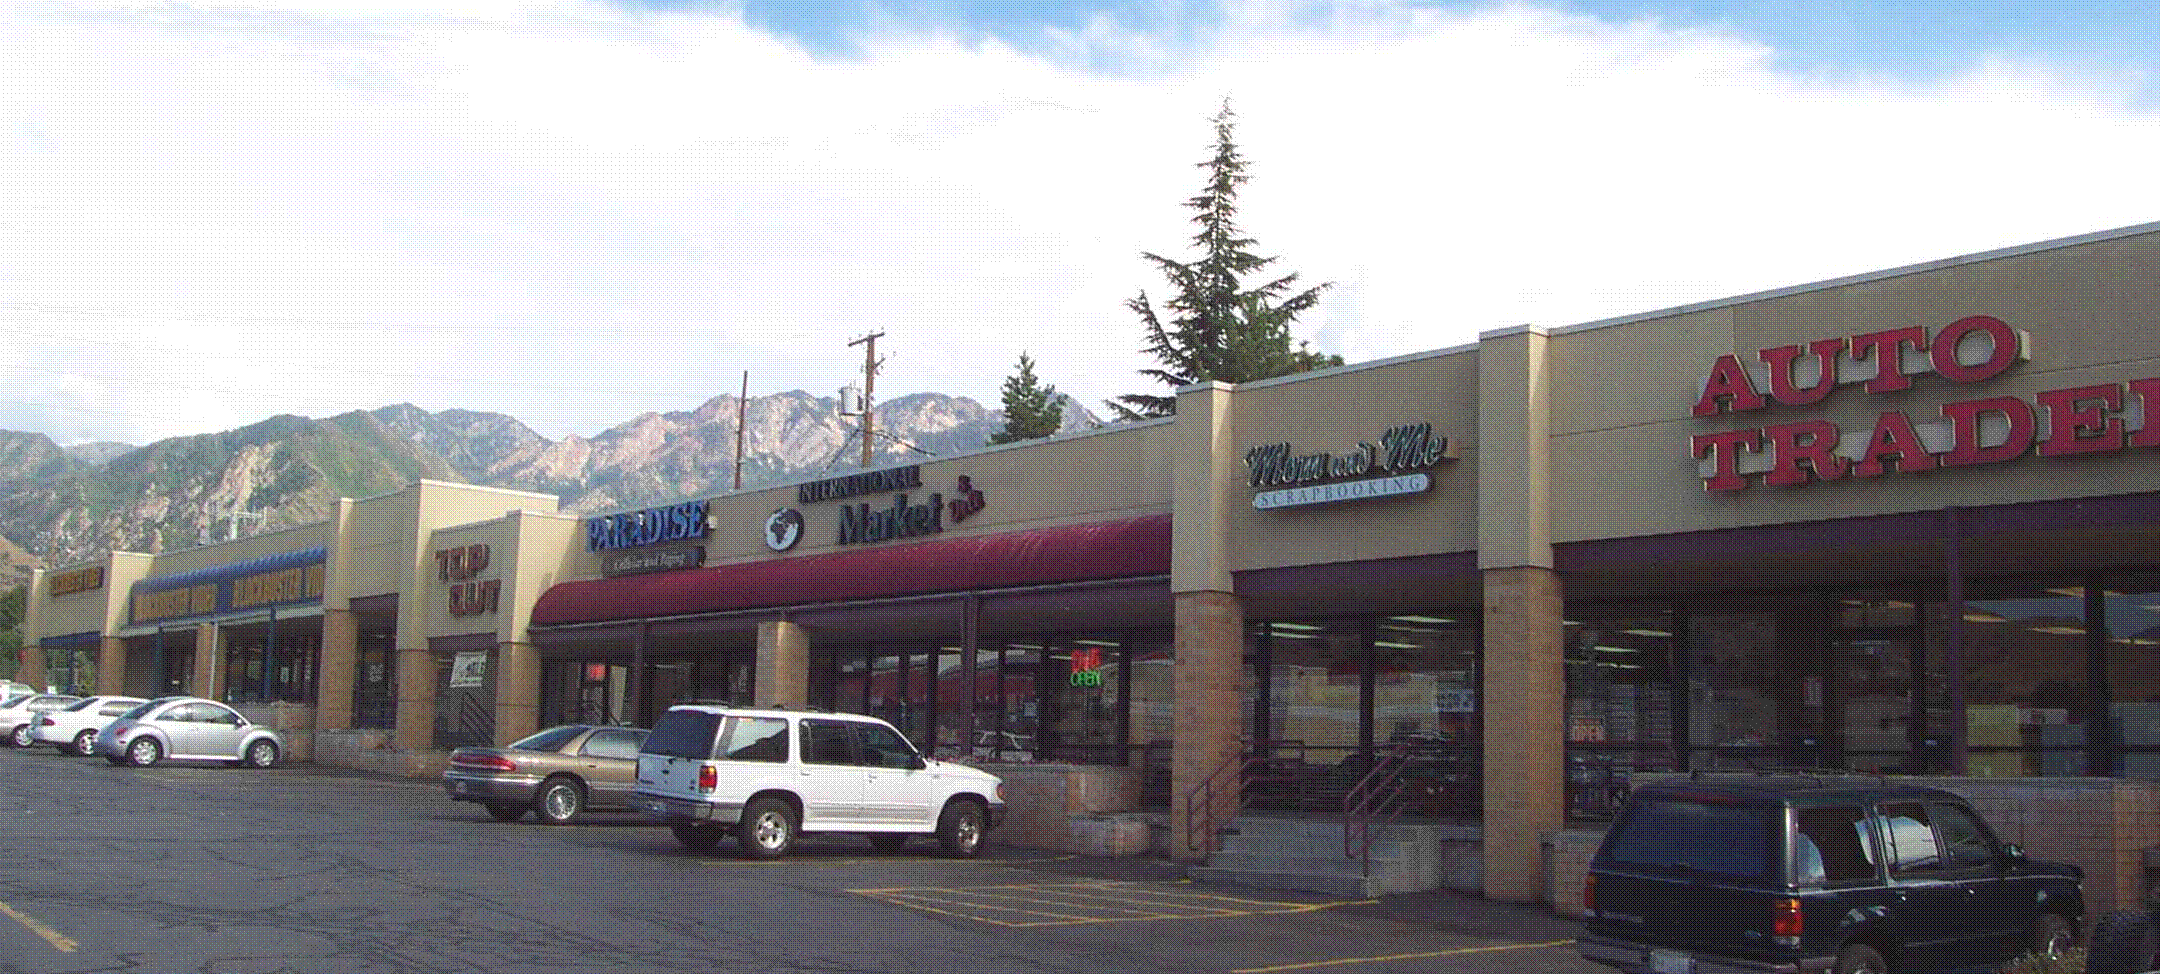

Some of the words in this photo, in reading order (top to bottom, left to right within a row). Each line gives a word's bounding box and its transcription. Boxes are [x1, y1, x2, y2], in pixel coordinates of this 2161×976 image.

[1690, 315, 2019, 418] AUTO
[1244, 441, 1331, 485] Mom
[1328, 441, 1375, 477] and
[1378, 421, 1448, 470] Me
[799, 465, 921, 504] INTERNATIONAL
[1259, 476, 1423, 507] SCRAPBOOKING
[586, 500, 710, 553] PARADISE
[839, 493, 943, 546] Market
[435, 544, 490, 583] TOP
[233, 568, 302, 608] BLOCKBUSTER
[1070, 670, 1102, 687] OPEN
[1572, 725, 1604, 742] OPEN
